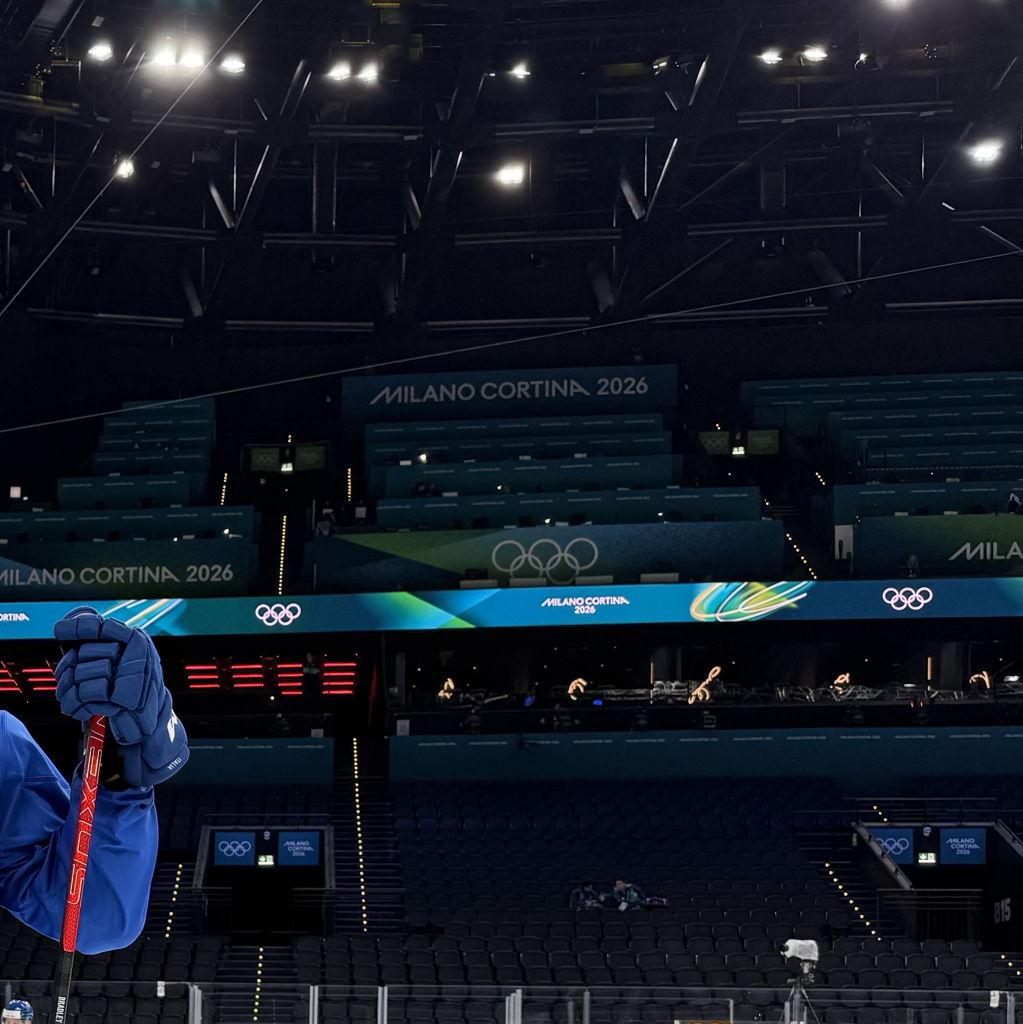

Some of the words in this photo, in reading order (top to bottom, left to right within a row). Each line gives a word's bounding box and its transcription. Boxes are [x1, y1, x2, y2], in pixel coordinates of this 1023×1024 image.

[369, 383, 475, 405] MILANO
[481, 379, 590, 400] CORTINA
[596, 376, 648, 396] 2026
[79, 565, 180, 584] CORTINA
[185, 564, 233, 583] 2026
[541, 597, 583, 606] MILANO
[585, 596, 629, 605] CORTINA
[574, 605, 596, 614] 2026
[55, 997, 66, 1024] BRADLEY
